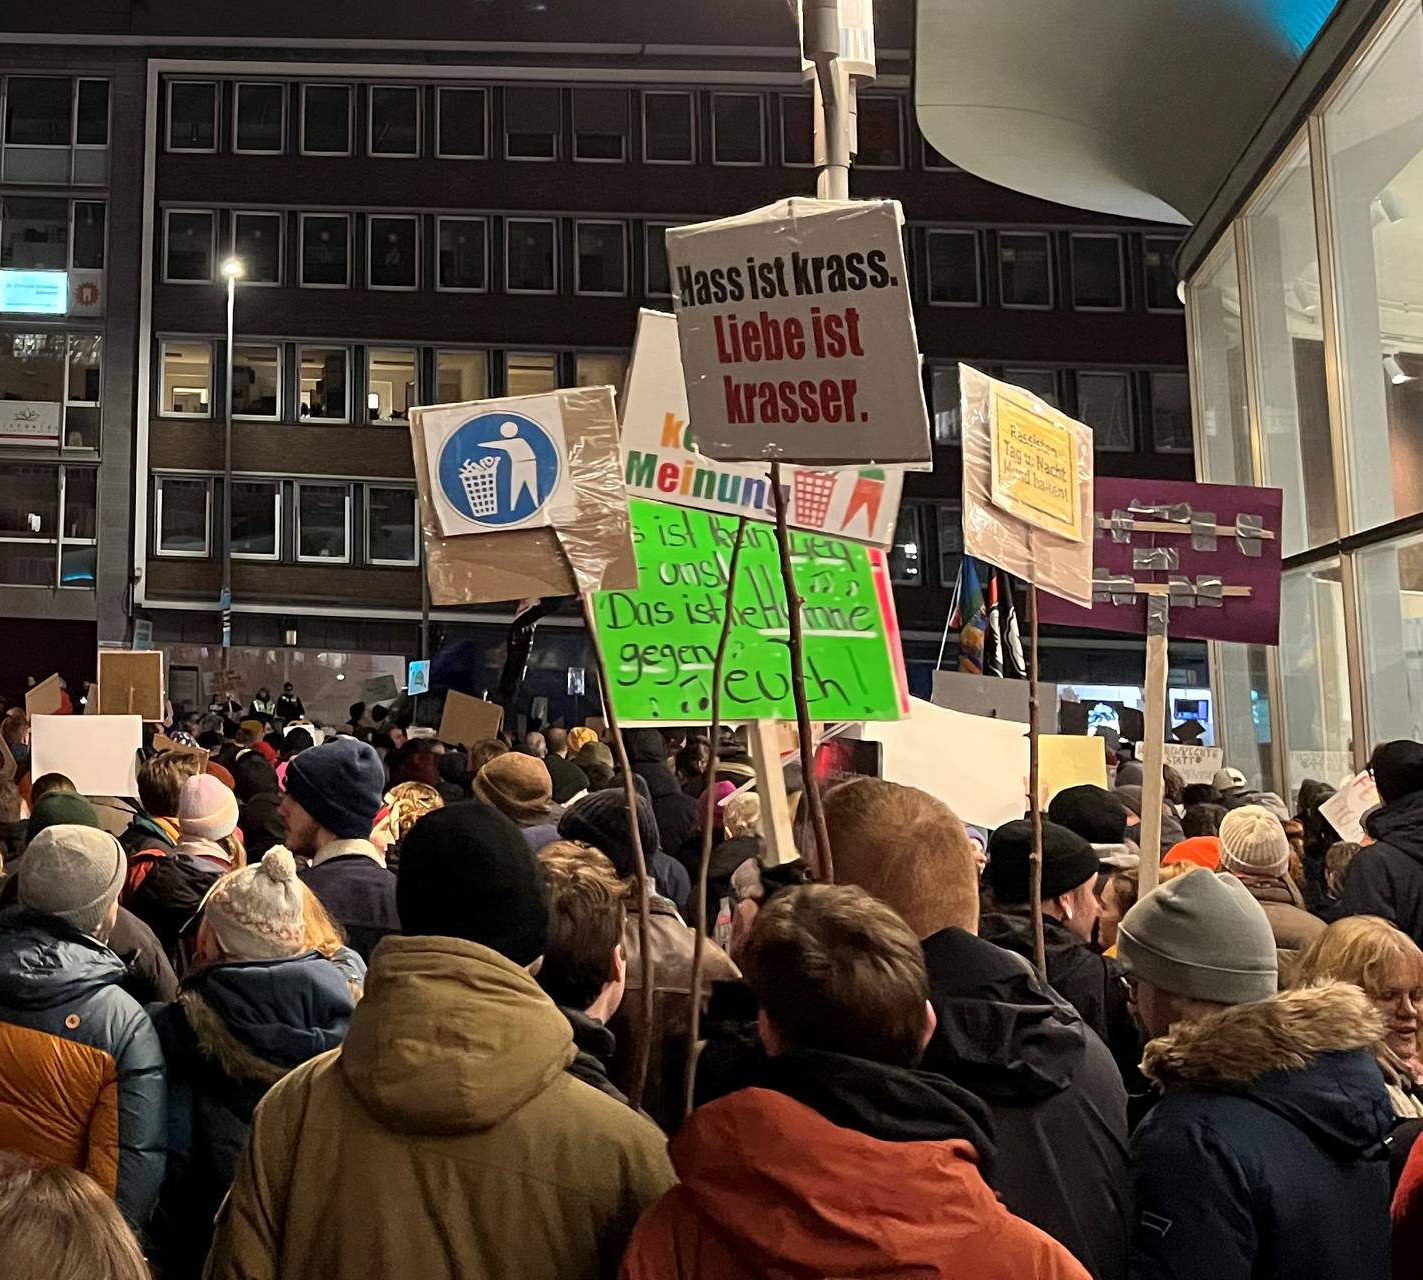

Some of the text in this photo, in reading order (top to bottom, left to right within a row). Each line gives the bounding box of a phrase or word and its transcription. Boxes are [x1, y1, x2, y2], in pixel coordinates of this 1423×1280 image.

[677, 249, 899, 307] Hass ist krass.
[713, 307, 865, 364] Liebe ist
[723, 375, 869, 424] krasser.
[626, 450, 791, 517] Meinung
[1003, 439, 1022, 464] Tag
[1036, 455, 1067, 482] Nacht
[655, 510, 698, 549] ist
[606, 592, 675, 629] Das
[682, 593, 722, 626] ist
[615, 642, 716, 687] gegen
[724, 645, 874, 714] euh!
